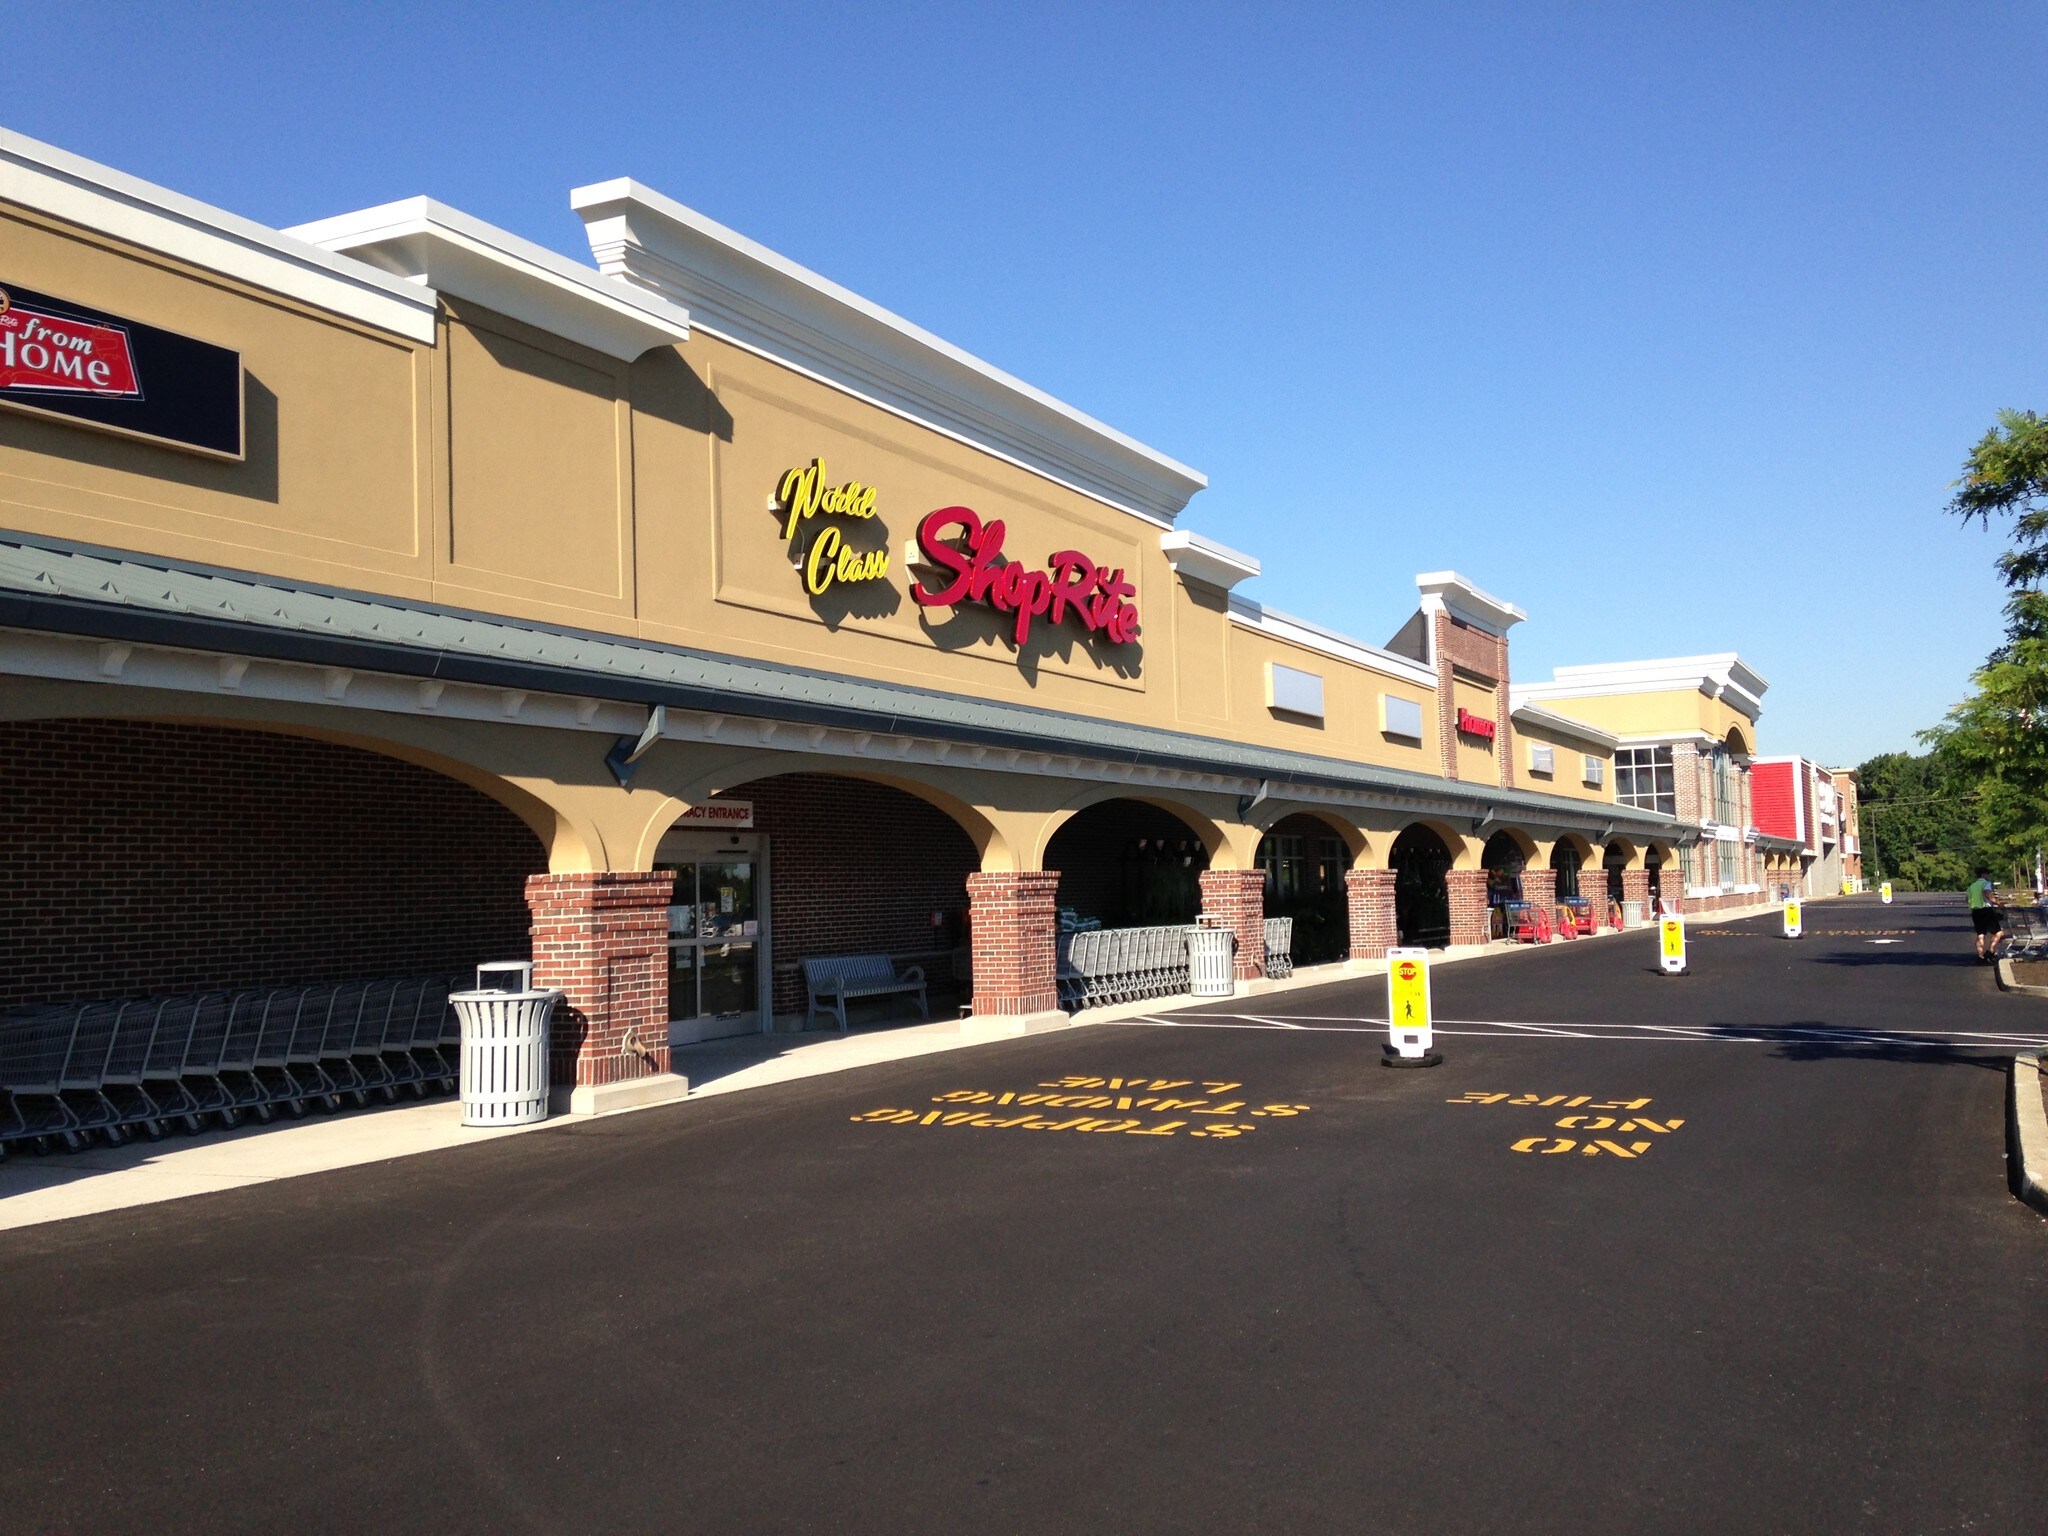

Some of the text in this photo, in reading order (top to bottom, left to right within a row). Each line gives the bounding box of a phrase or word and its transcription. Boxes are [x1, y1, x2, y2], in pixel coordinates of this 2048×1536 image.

[18, 318, 93, 356] from
[779, 457, 878, 540] World
[805, 526, 890, 596] Class
[910, 505, 1140, 646] ShopRite
[708, 807, 749, 820] ENTRANCE
[1398, 967, 1417, 976] STOP
[931, 1089, 1685, 1134] NO STANDING
[1038, 1075, 1652, 1110] FIRE LANE
[850, 1107, 1652, 1159] NO STOPPING
